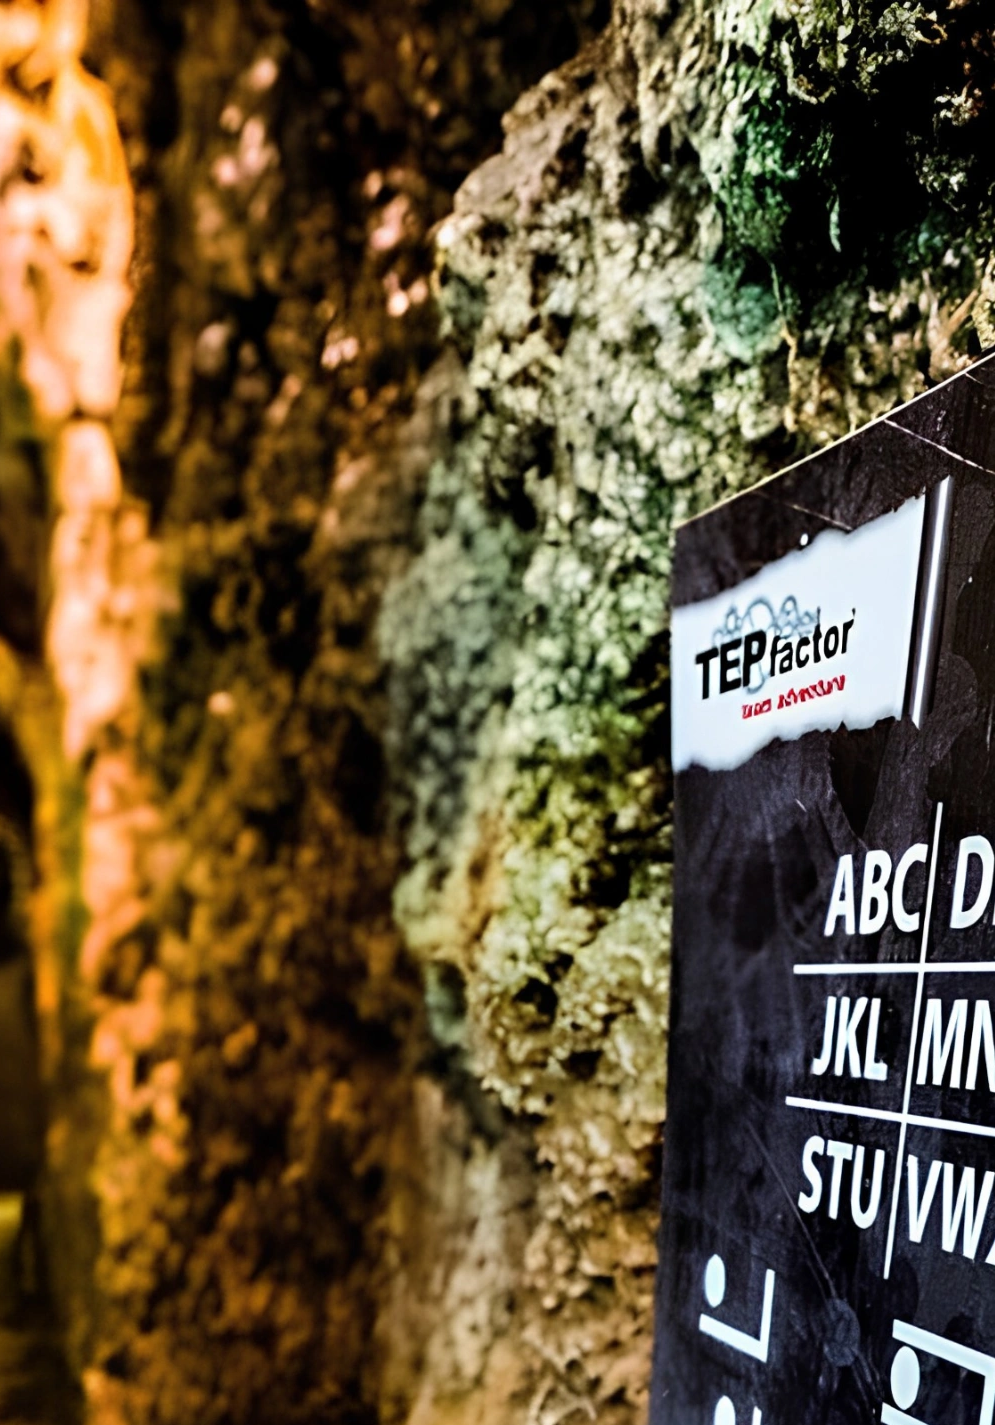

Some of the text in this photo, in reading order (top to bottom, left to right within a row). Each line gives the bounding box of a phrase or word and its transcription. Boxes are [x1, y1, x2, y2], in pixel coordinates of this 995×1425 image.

[823, 834, 995, 937] ABC D
[811, 996, 888, 1082] JKL
[798, 1135, 995, 1266] STU VW
